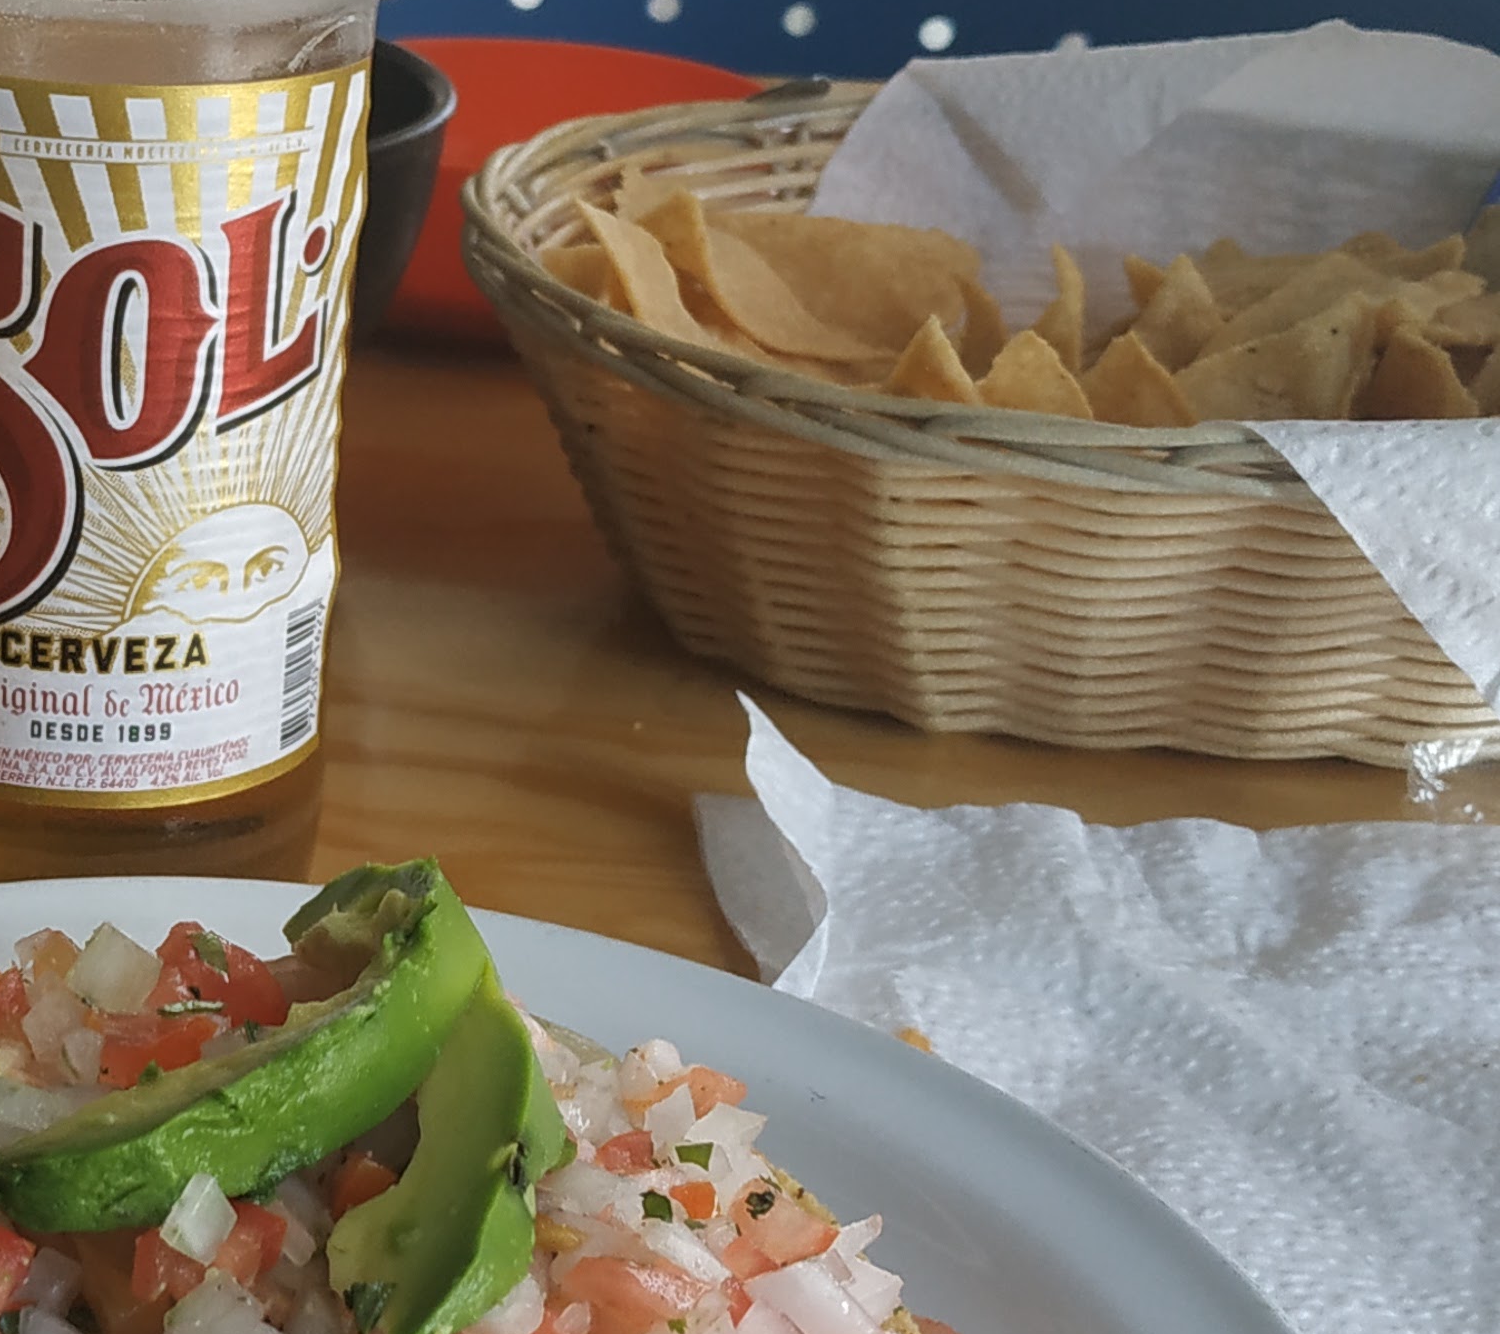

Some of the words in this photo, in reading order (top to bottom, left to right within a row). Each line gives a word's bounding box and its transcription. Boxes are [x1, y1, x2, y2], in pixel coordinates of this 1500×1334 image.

[0, 630, 210, 674] CERVEZA
[104, 690, 130, 718] de
[139, 679, 240, 715] México
[30, 720, 104, 742] DESDE
[118, 722, 172, 743] 1899
[13, 747, 63, 764] MÉXICO
[99, 749, 174, 766] CERVECERÍA
[55, 764, 72, 777] DE
